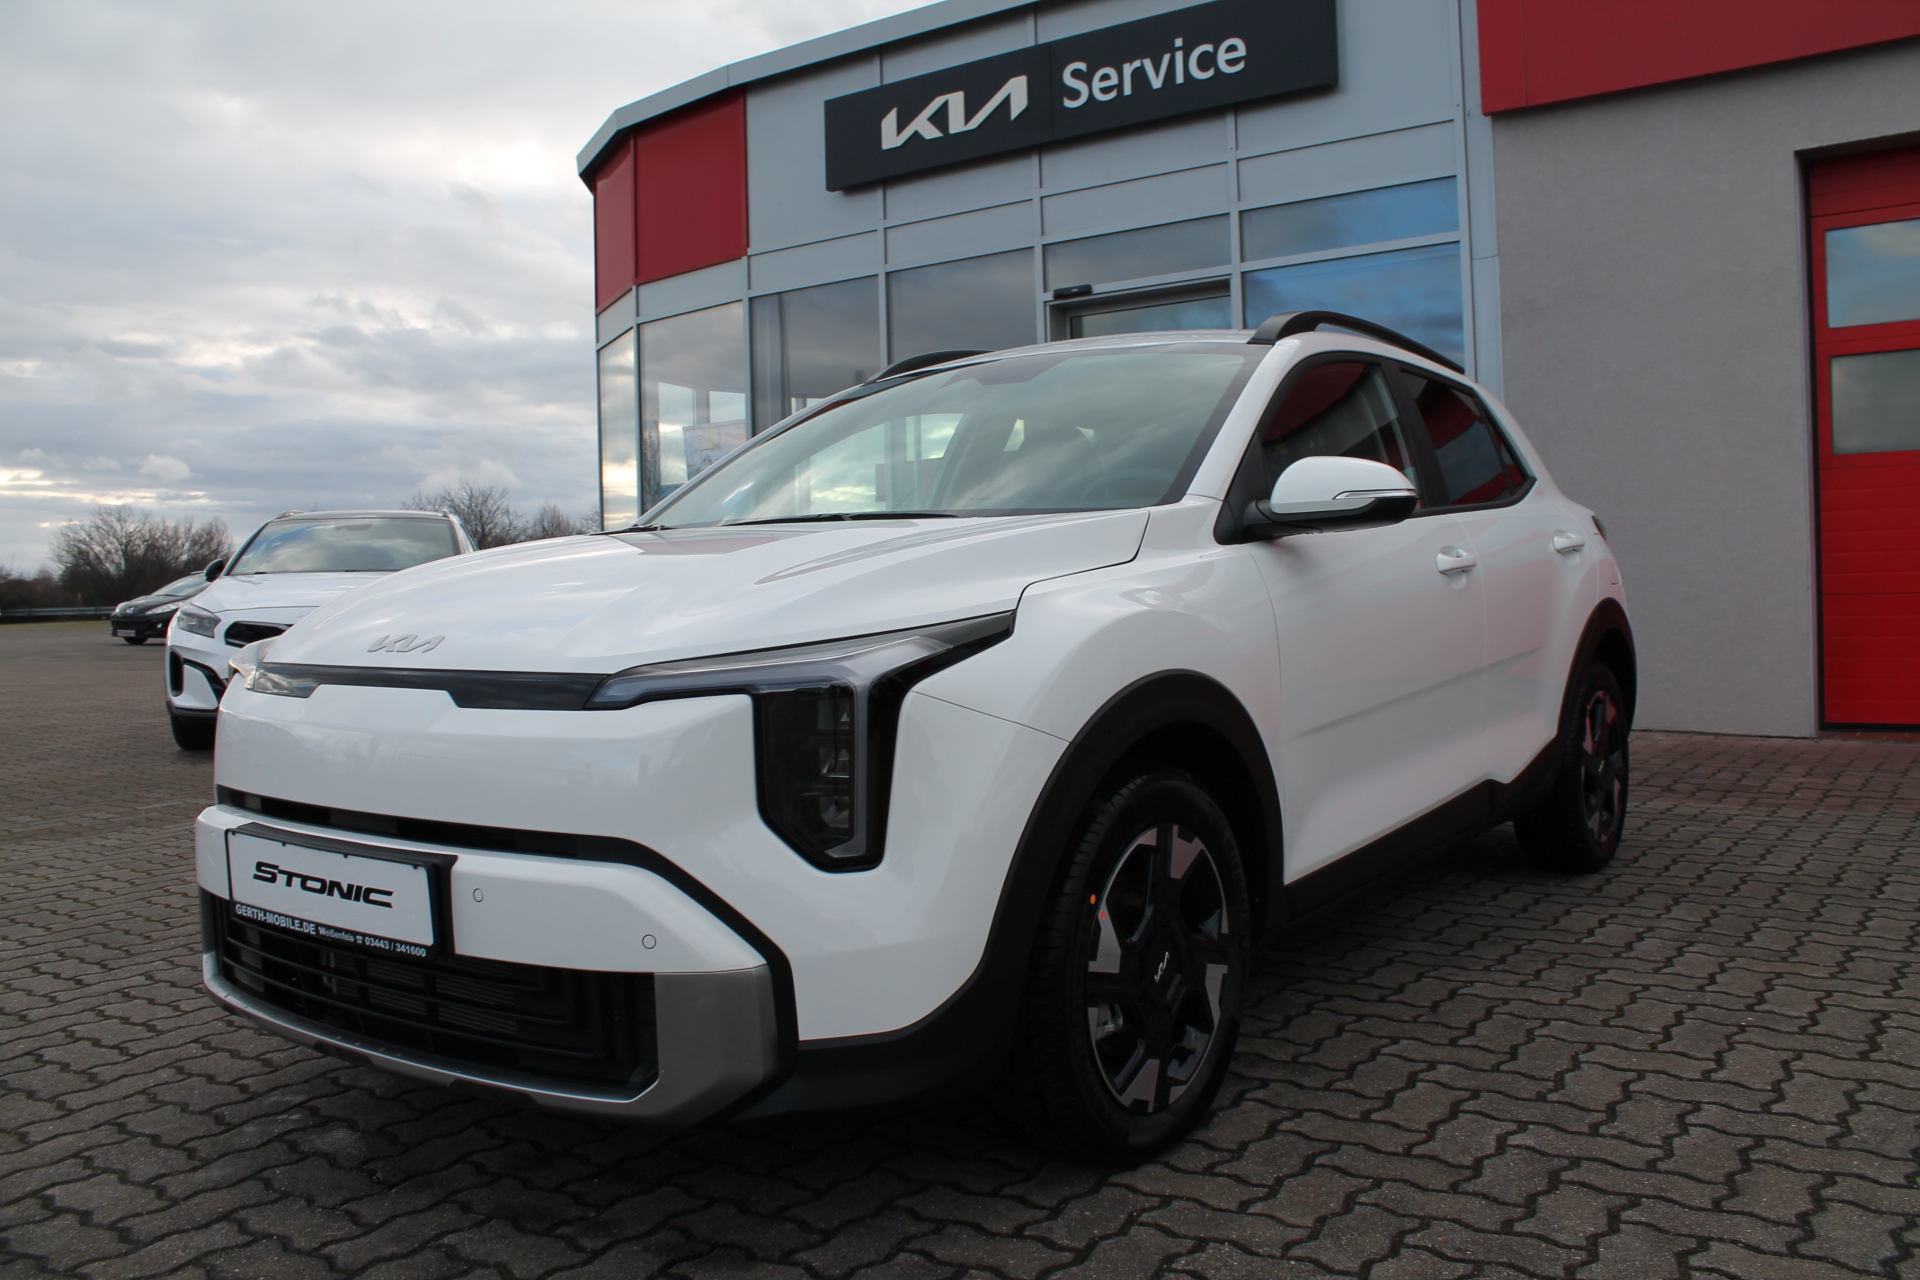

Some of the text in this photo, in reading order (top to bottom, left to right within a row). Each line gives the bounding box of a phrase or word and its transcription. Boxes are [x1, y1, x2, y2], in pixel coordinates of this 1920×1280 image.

[881, 37, 1247, 150] KIA Service
[367, 634, 446, 654] KIA
[253, 861, 394, 908] STONIC
[235, 903, 316, 934] GERTH-MOBILE.DE
[365, 937, 389, 949] 03443
[396, 943, 426, 957] 341600
